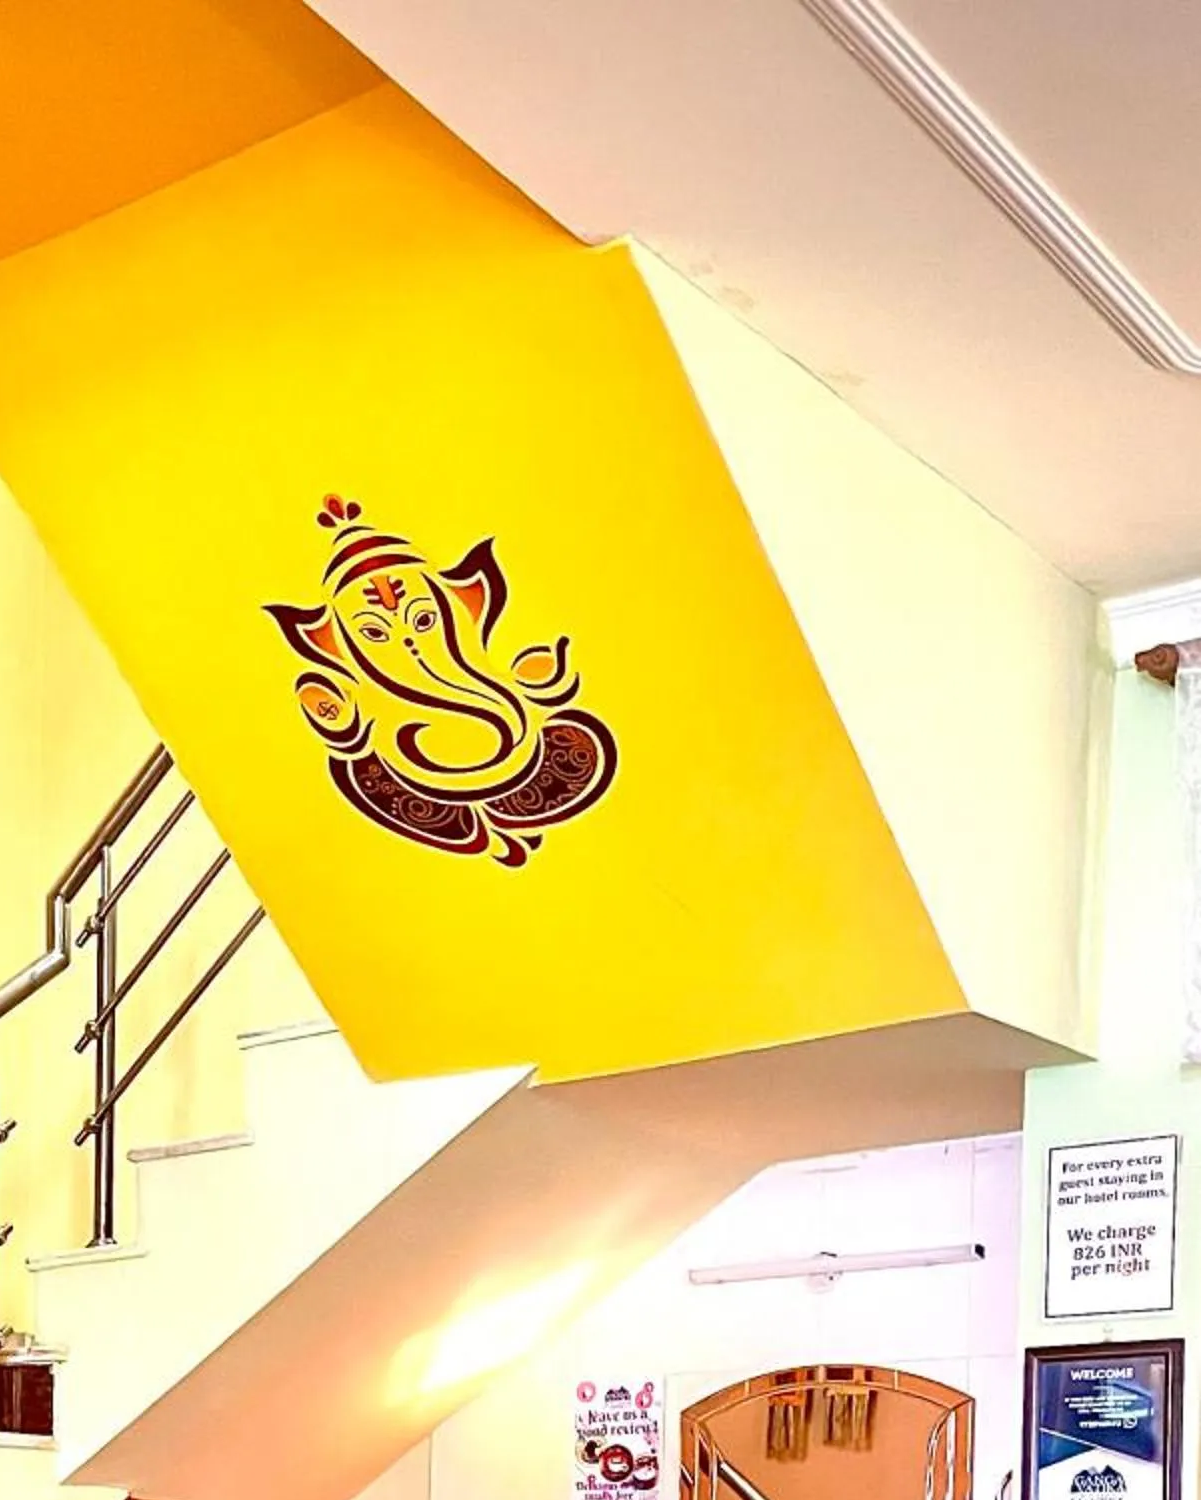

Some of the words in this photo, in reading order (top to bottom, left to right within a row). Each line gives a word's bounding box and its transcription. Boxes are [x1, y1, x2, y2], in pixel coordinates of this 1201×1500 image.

[1062, 1162, 1084, 1174] For
[1086, 1159, 1124, 1171] every
[1126, 1155, 1162, 1166] extra
[1059, 1177, 1094, 1192] guest
[1098, 1172, 1148, 1187] staying
[1150, 1169, 1164, 1181] in
[1057, 1195, 1081, 1206] our
[1084, 1190, 1119, 1204] hotel
[1067, 1227, 1092, 1242] We
[1097, 1225, 1156, 1241] charge
[1073, 1245, 1106, 1261] 826
[1111, 1243, 1142, 1258] INR
[1071, 1263, 1101, 1281] per
[1105, 1258, 1150, 1277] night
[1070, 1367, 1134, 1381] WELCOME
